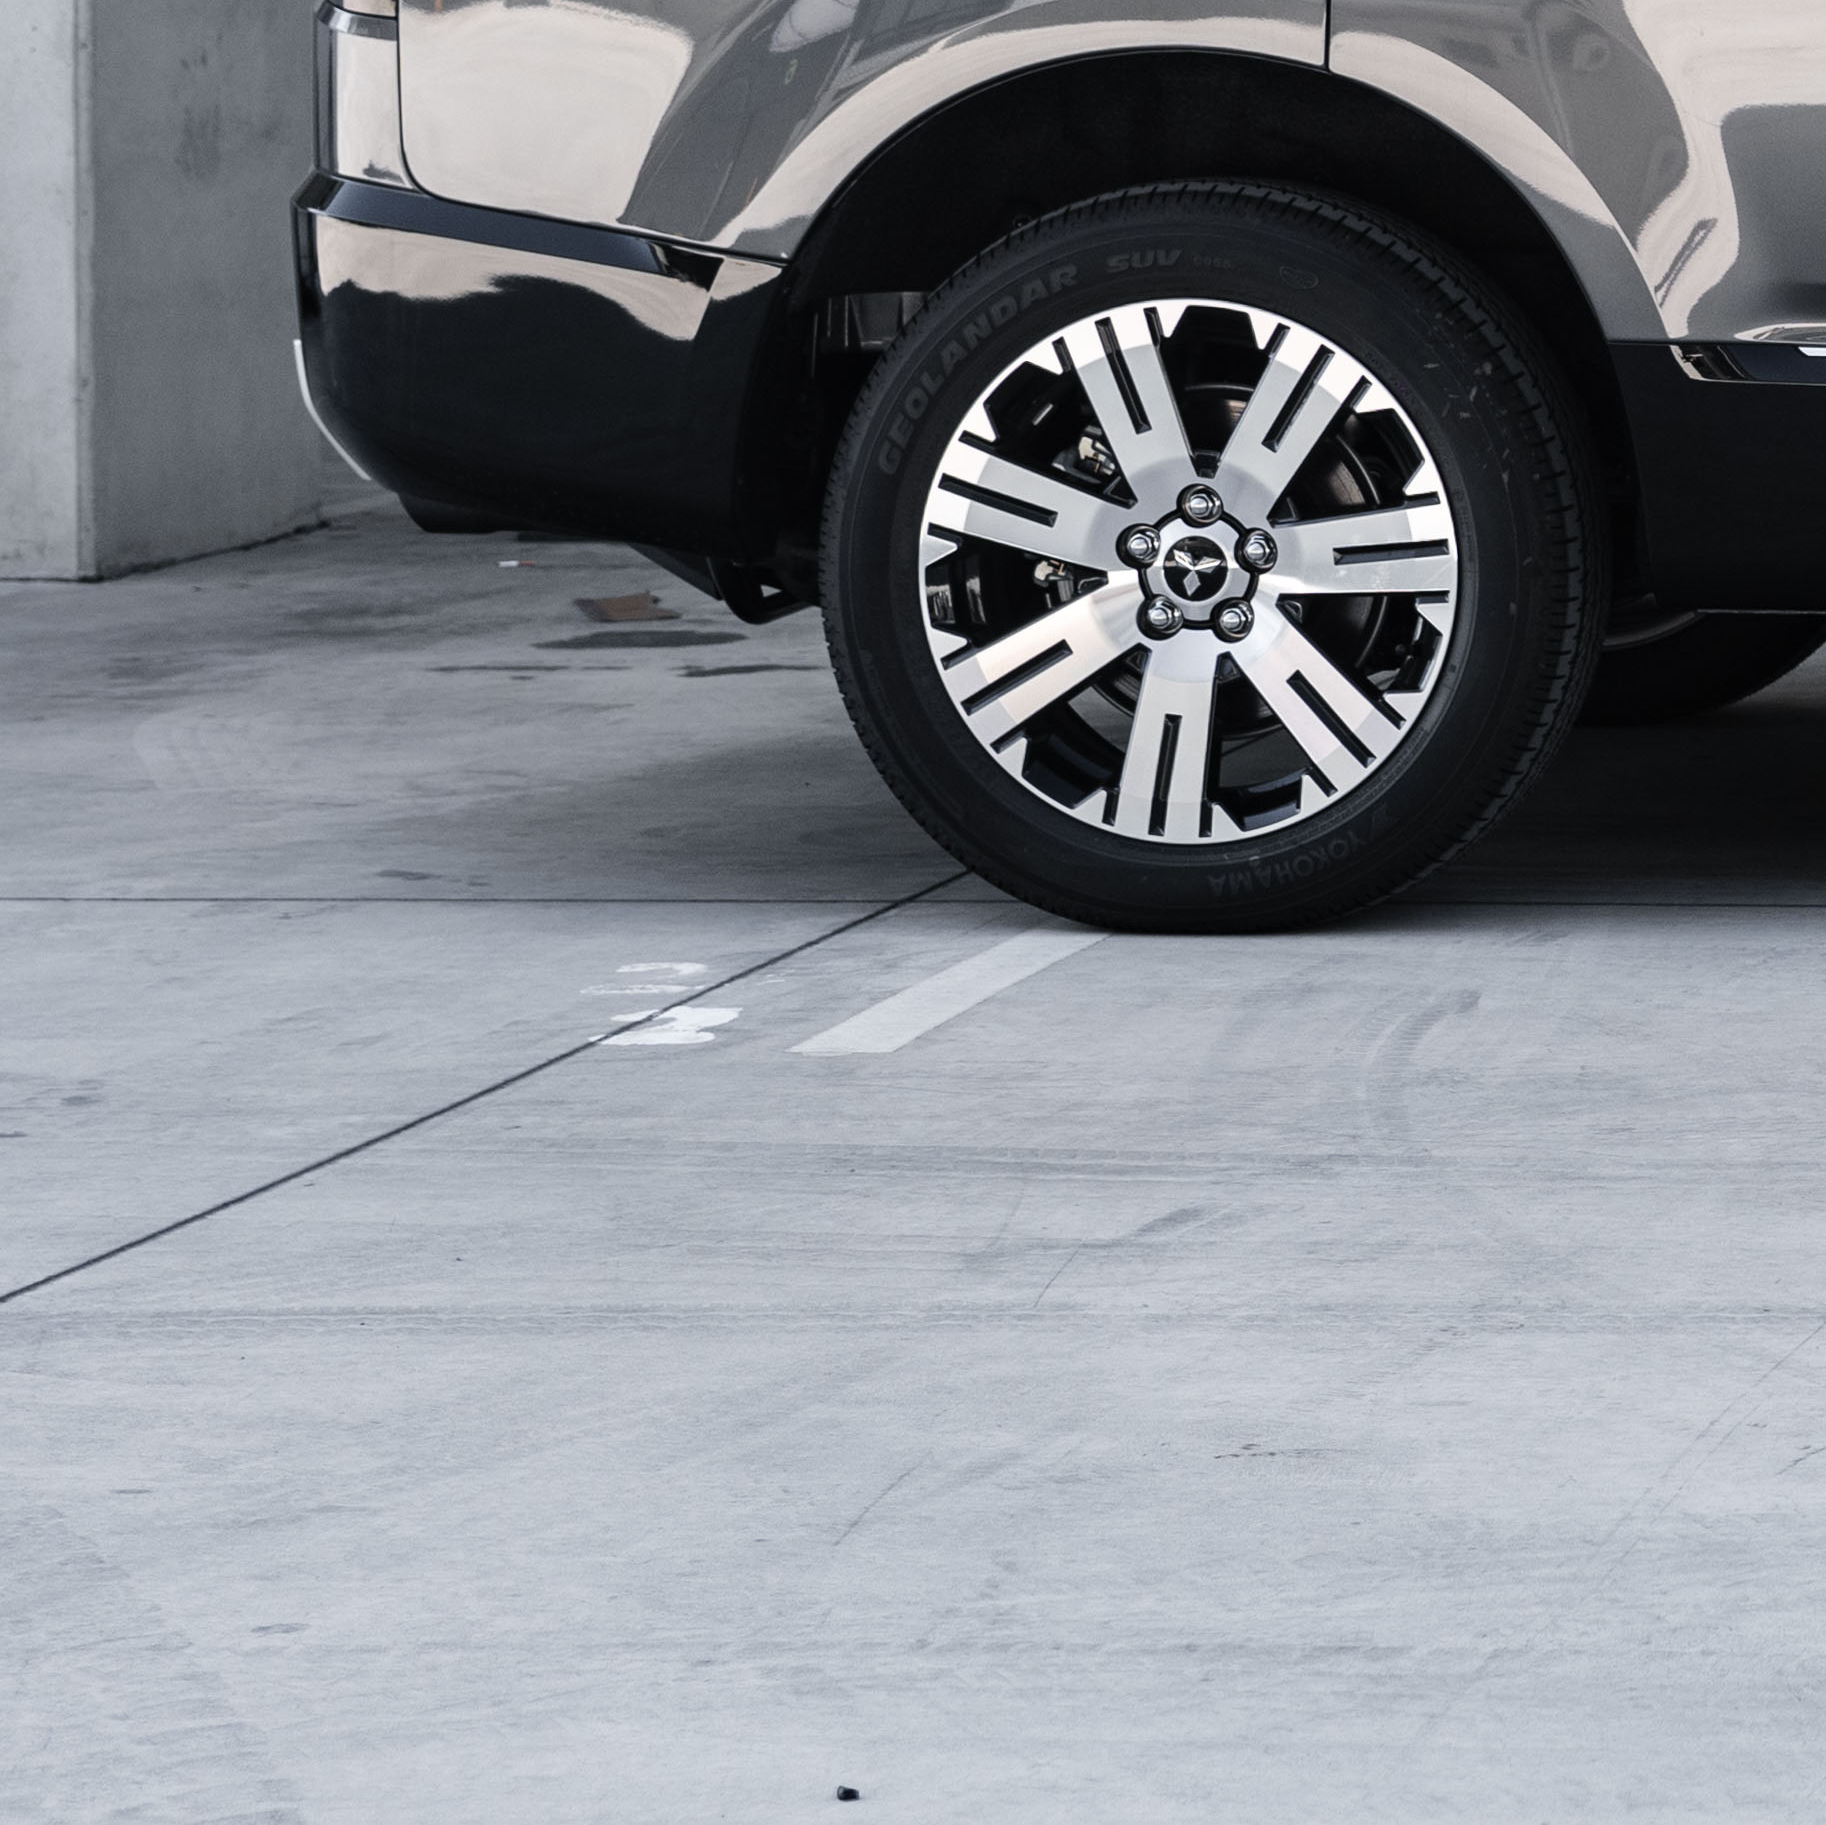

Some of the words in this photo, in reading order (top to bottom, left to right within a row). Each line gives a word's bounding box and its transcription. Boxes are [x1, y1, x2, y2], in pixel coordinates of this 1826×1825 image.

[877, 266, 1078, 476] GEOLANDAR
[1105, 249, 1182, 275] SUV
[1209, 831, 1367, 895] YOKOHAMA
